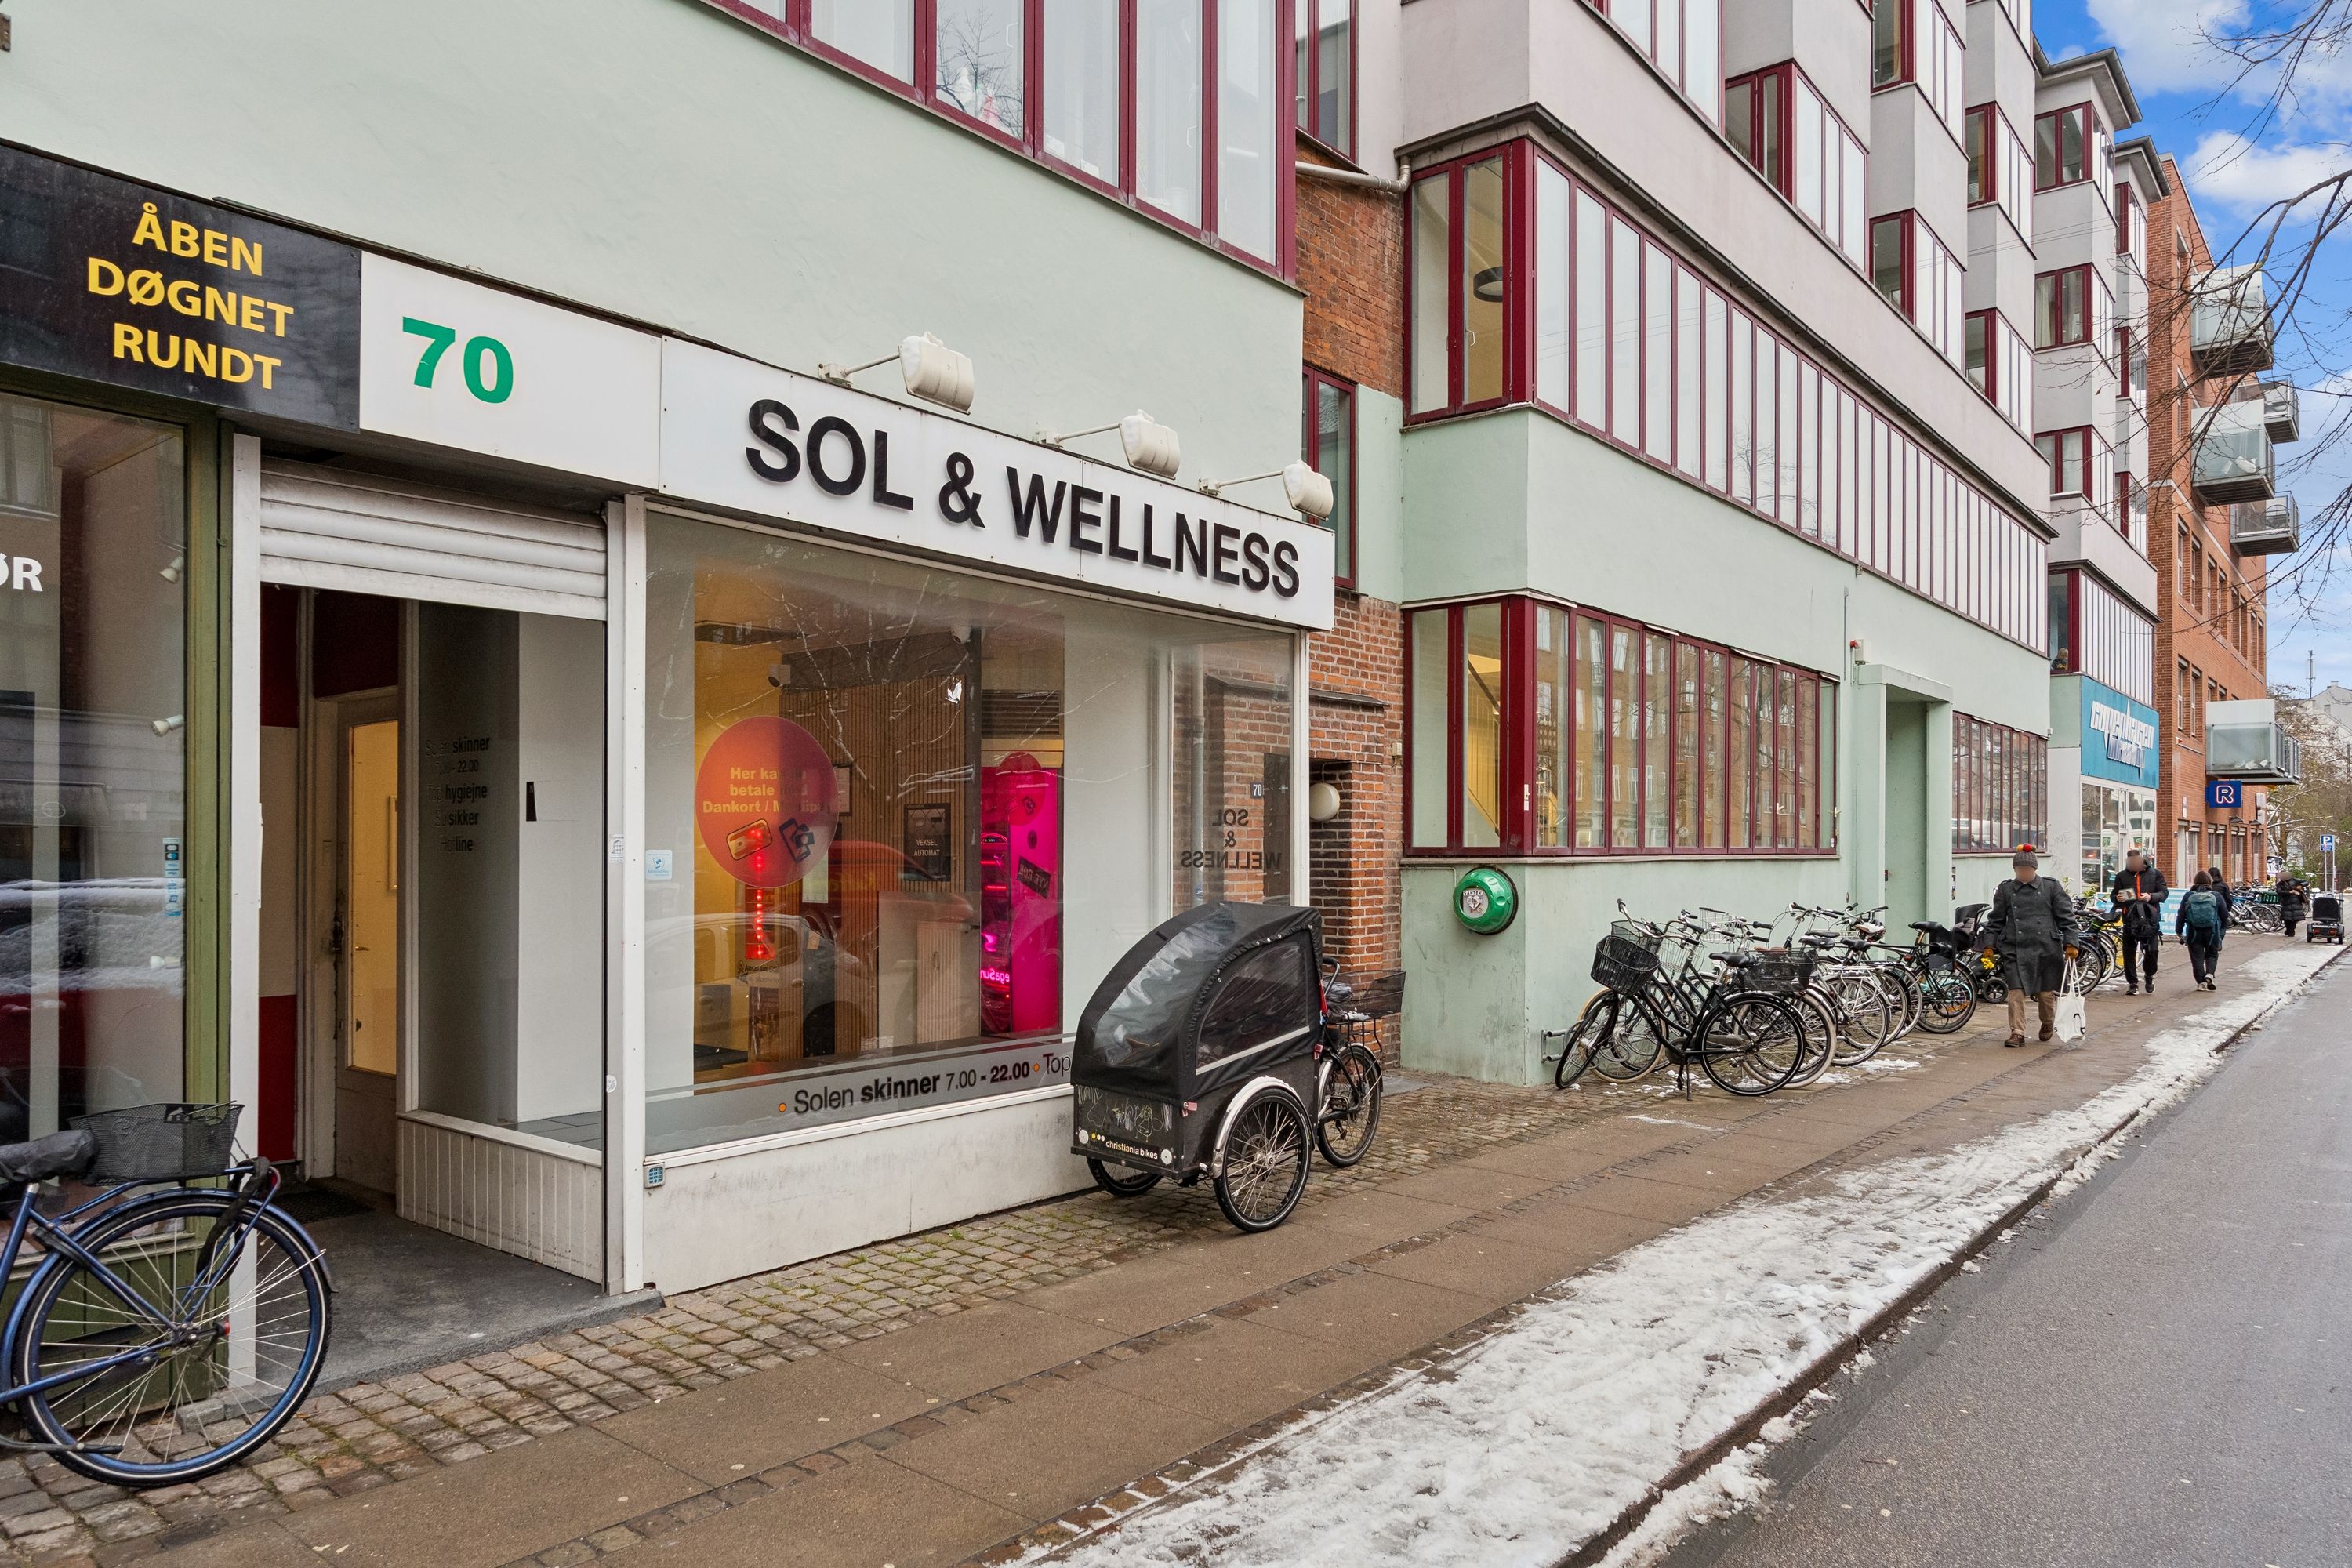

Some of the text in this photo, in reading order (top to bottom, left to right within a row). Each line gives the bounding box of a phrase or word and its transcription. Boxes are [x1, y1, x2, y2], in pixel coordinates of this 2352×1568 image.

[132, 201, 263, 276] ÅBEN
[88, 257, 295, 337] DØGNET
[113, 323, 282, 390] RUNDT
[402, 317, 514, 405] 70
[746, 398, 1301, 598] SOL & WELLNESS
[452, 736, 490, 753] skinner
[730, 767, 756, 779] Her
[760, 767, 782, 779] ka
[445, 782, 488, 804] hygiejne
[729, 784, 775, 796] betale
[1253, 784, 1262, 796] 70
[2216, 785, 2234, 804] R
[702, 800, 760, 813] Dankort
[793, 1086, 853, 1114] Solen
[861, 1074, 940, 1103] skinner
[946, 1069, 977, 1091] 7.00
[989, 1061, 1030, 1084] 22.00
[1043, 1053, 1071, 1077] Top
[1105, 1140, 1158, 1160] christiania bikes
